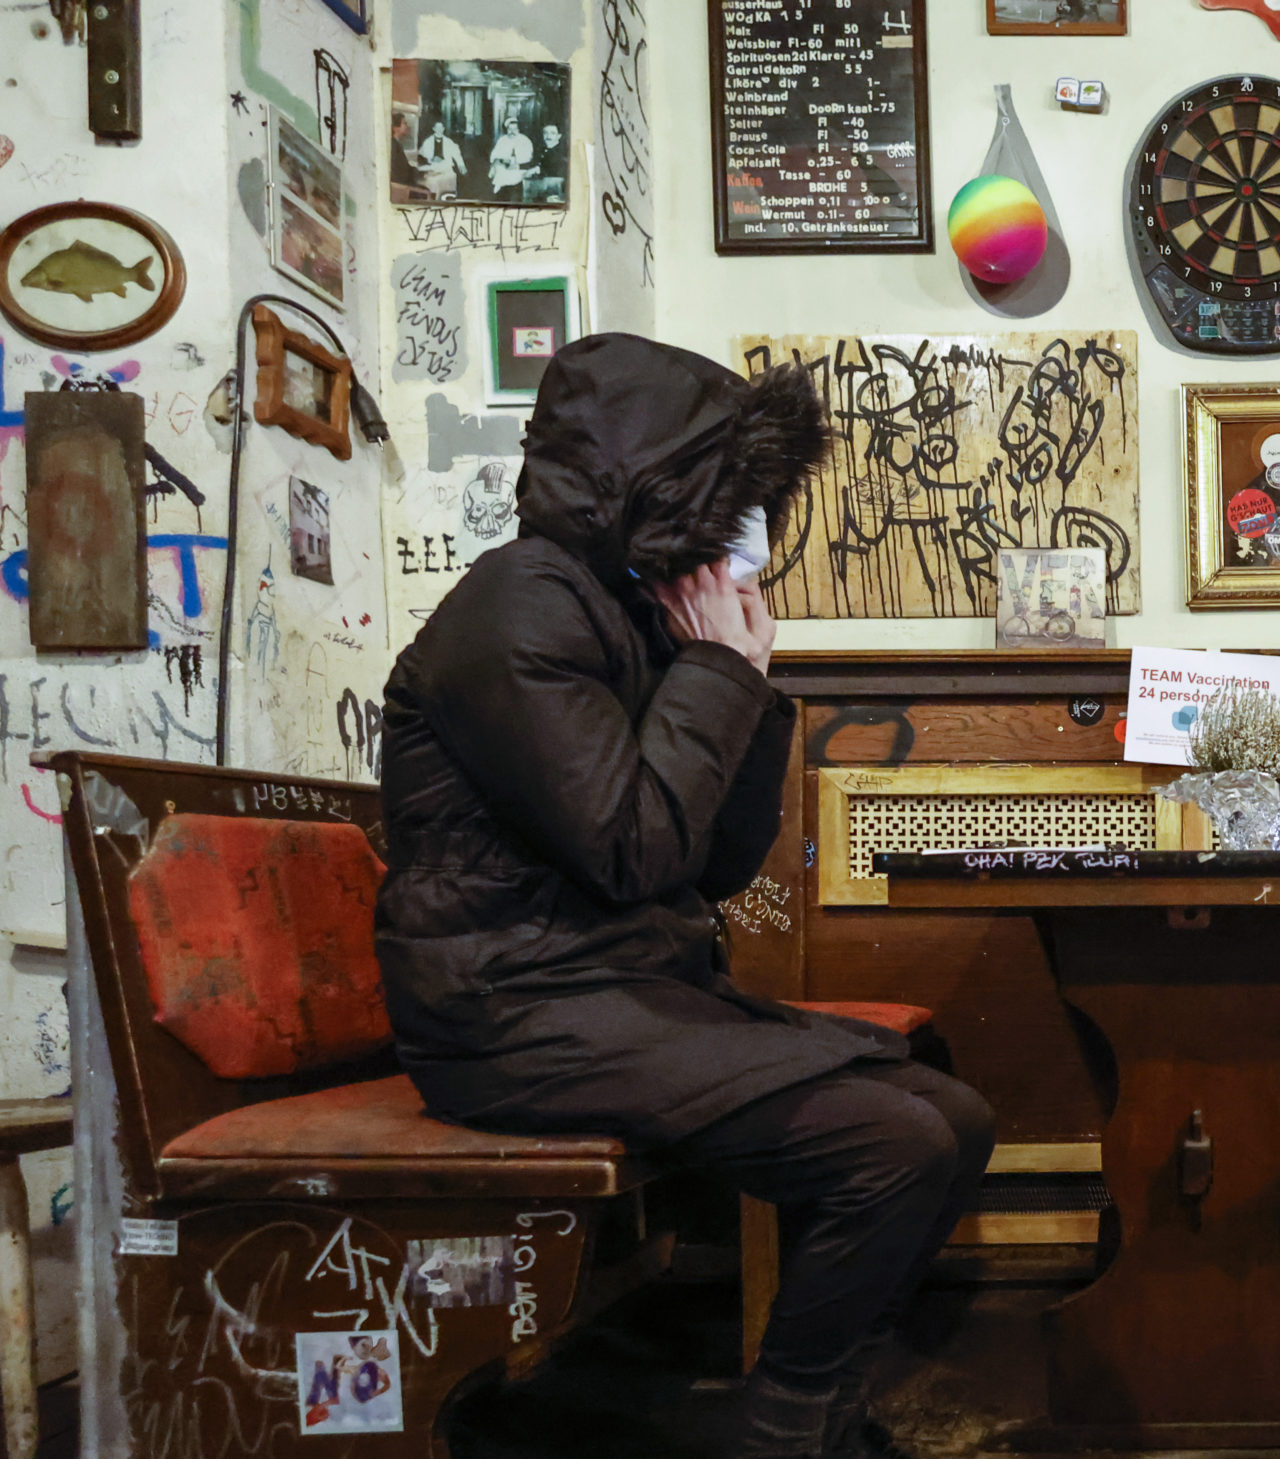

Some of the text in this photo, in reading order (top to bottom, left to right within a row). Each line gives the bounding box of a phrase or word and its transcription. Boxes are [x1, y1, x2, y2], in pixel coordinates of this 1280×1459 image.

[725, 26, 751, 36] Malz
[844, 24, 859, 34] 50
[726, 39, 782, 50] Weissbier
[809, 50, 846, 61] Klarer
[1212, 86, 1219, 98] 5
[1240, 82, 1254, 92] 20
[1276, 86, 1280, 97] 1
[726, 90, 789, 102] Weinbrand
[724, 104, 787, 116] Steinhäger
[1181, 100, 1193, 112] 12
[730, 118, 763, 129] Selter
[1161, 123, 1168, 135] 9
[729, 131, 768, 142] Brause
[729, 143, 786, 155] Coca-Cola
[728, 158, 781, 169] Apfelsaft
[1144, 152, 1157, 163] 14
[779, 169, 811, 181] Tasse
[836, 169, 852, 181] 60
[1140, 184, 1151, 195] 11
[760, 196, 814, 210] Schoppen
[761, 209, 806, 220] Wermut
[855, 209, 870, 220] 60
[1147, 215, 1155, 227] 8
[801, 222, 890, 234] Getränkesteuer
[1159, 244, 1172, 256] 16
[1184, 266, 1191, 278] 7
[1210, 281, 1223, 293] 19
[1244, 286, 1251, 298] 3
[1140, 668, 1270, 690] TEAM Vaccination
[1138, 686, 1156, 699] 24
[964, 852, 1014, 870] OHA!
